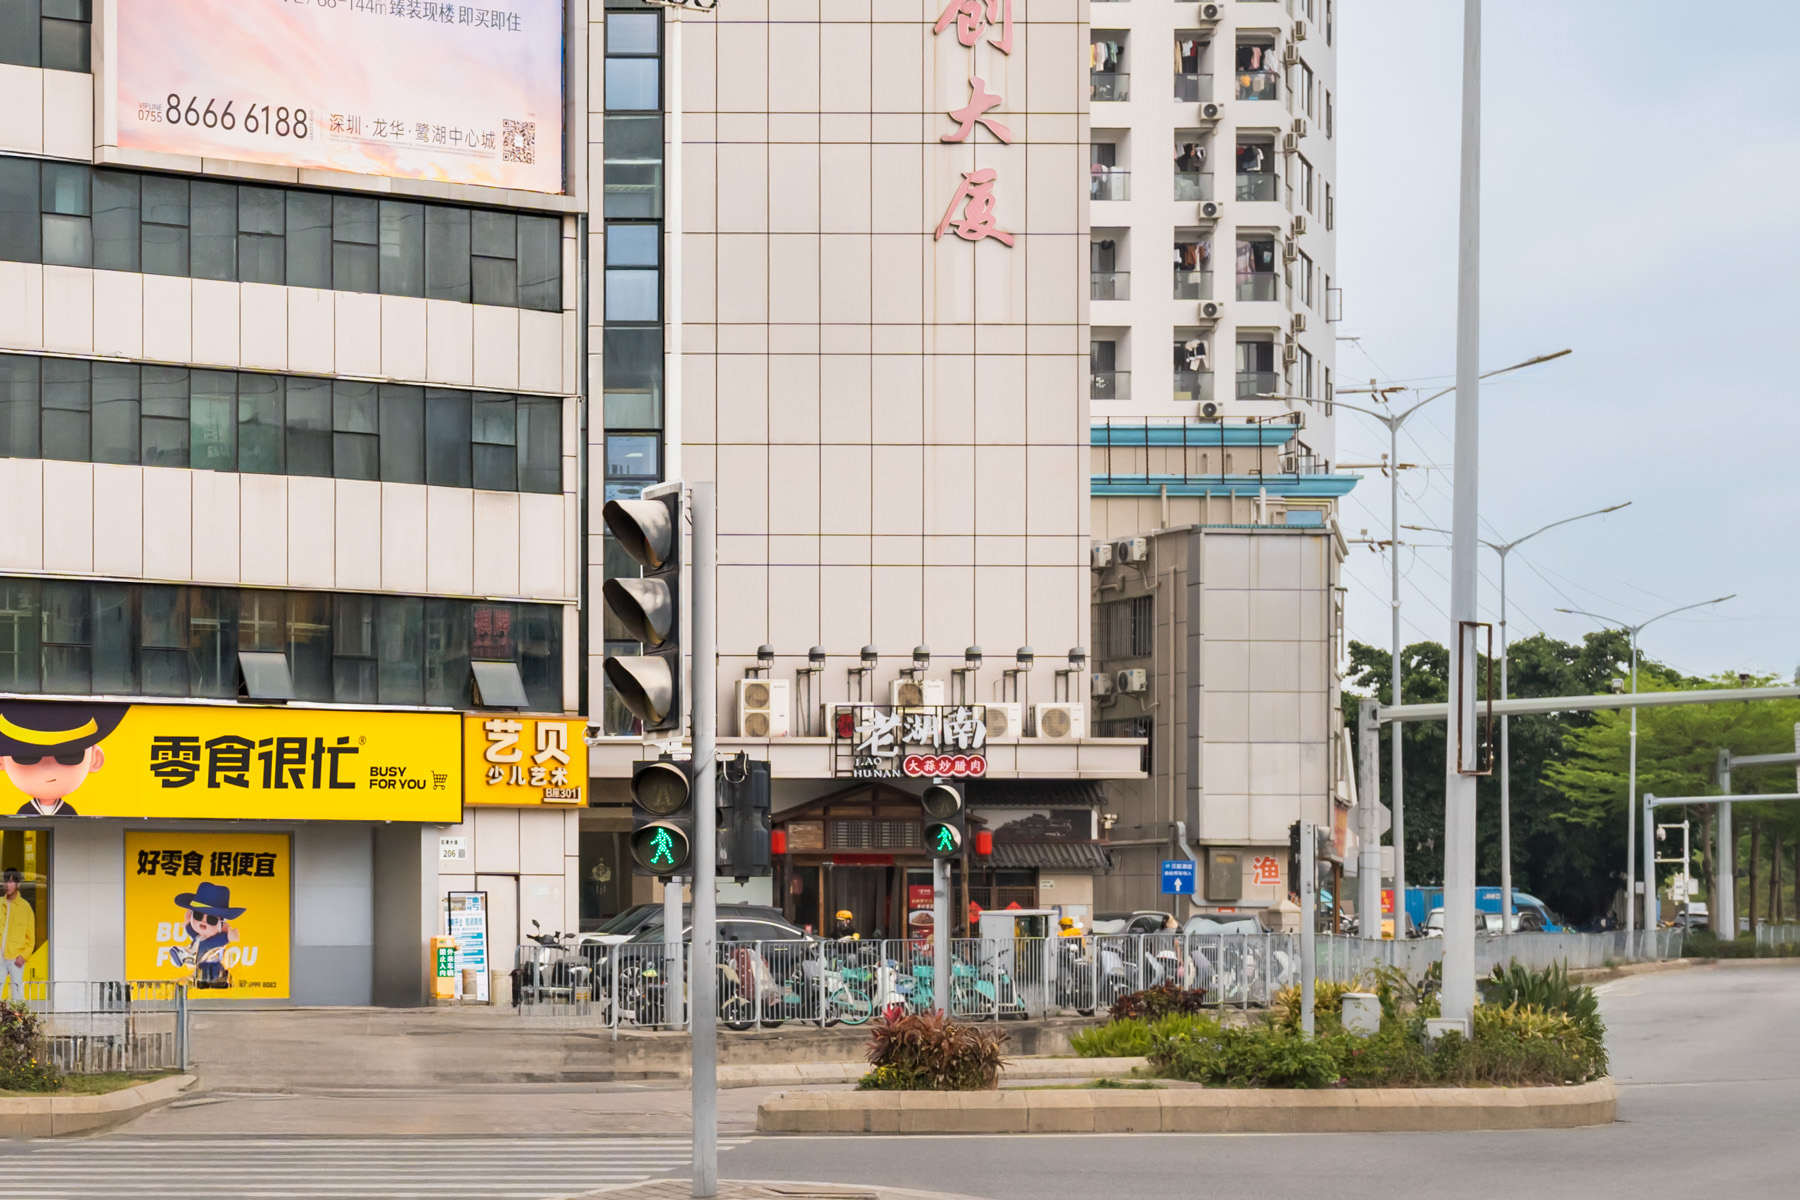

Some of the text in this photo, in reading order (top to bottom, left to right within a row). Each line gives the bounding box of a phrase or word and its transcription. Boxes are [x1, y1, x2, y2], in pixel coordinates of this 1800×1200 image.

[459, 5, 522, 32] 即买即住
[138, 109, 163, 123] 0755
[166, 93, 236, 131] 8666
[244, 103, 308, 139] 6188
[854, 705, 987, 757] 老湖南
[484, 719, 570, 765] 艺贝
[150, 735, 361, 789] 零食很忙
[370, 766, 407, 777] BUSY
[855, 757, 882, 766] LAO
[908, 760, 981, 772] 大蒜炒腊肉
[370, 779, 426, 790] FOR YOU
[486, 766, 569, 787] 少儿艺术
[545, 788, 579, 798] B座301
[137, 850, 277, 877] 好零食 很便宜
[443, 850, 456, 858] 206
[1252, 856, 1281, 885] 渔
[156, 922, 187, 942] BU
[228, 947, 258, 968] OU
